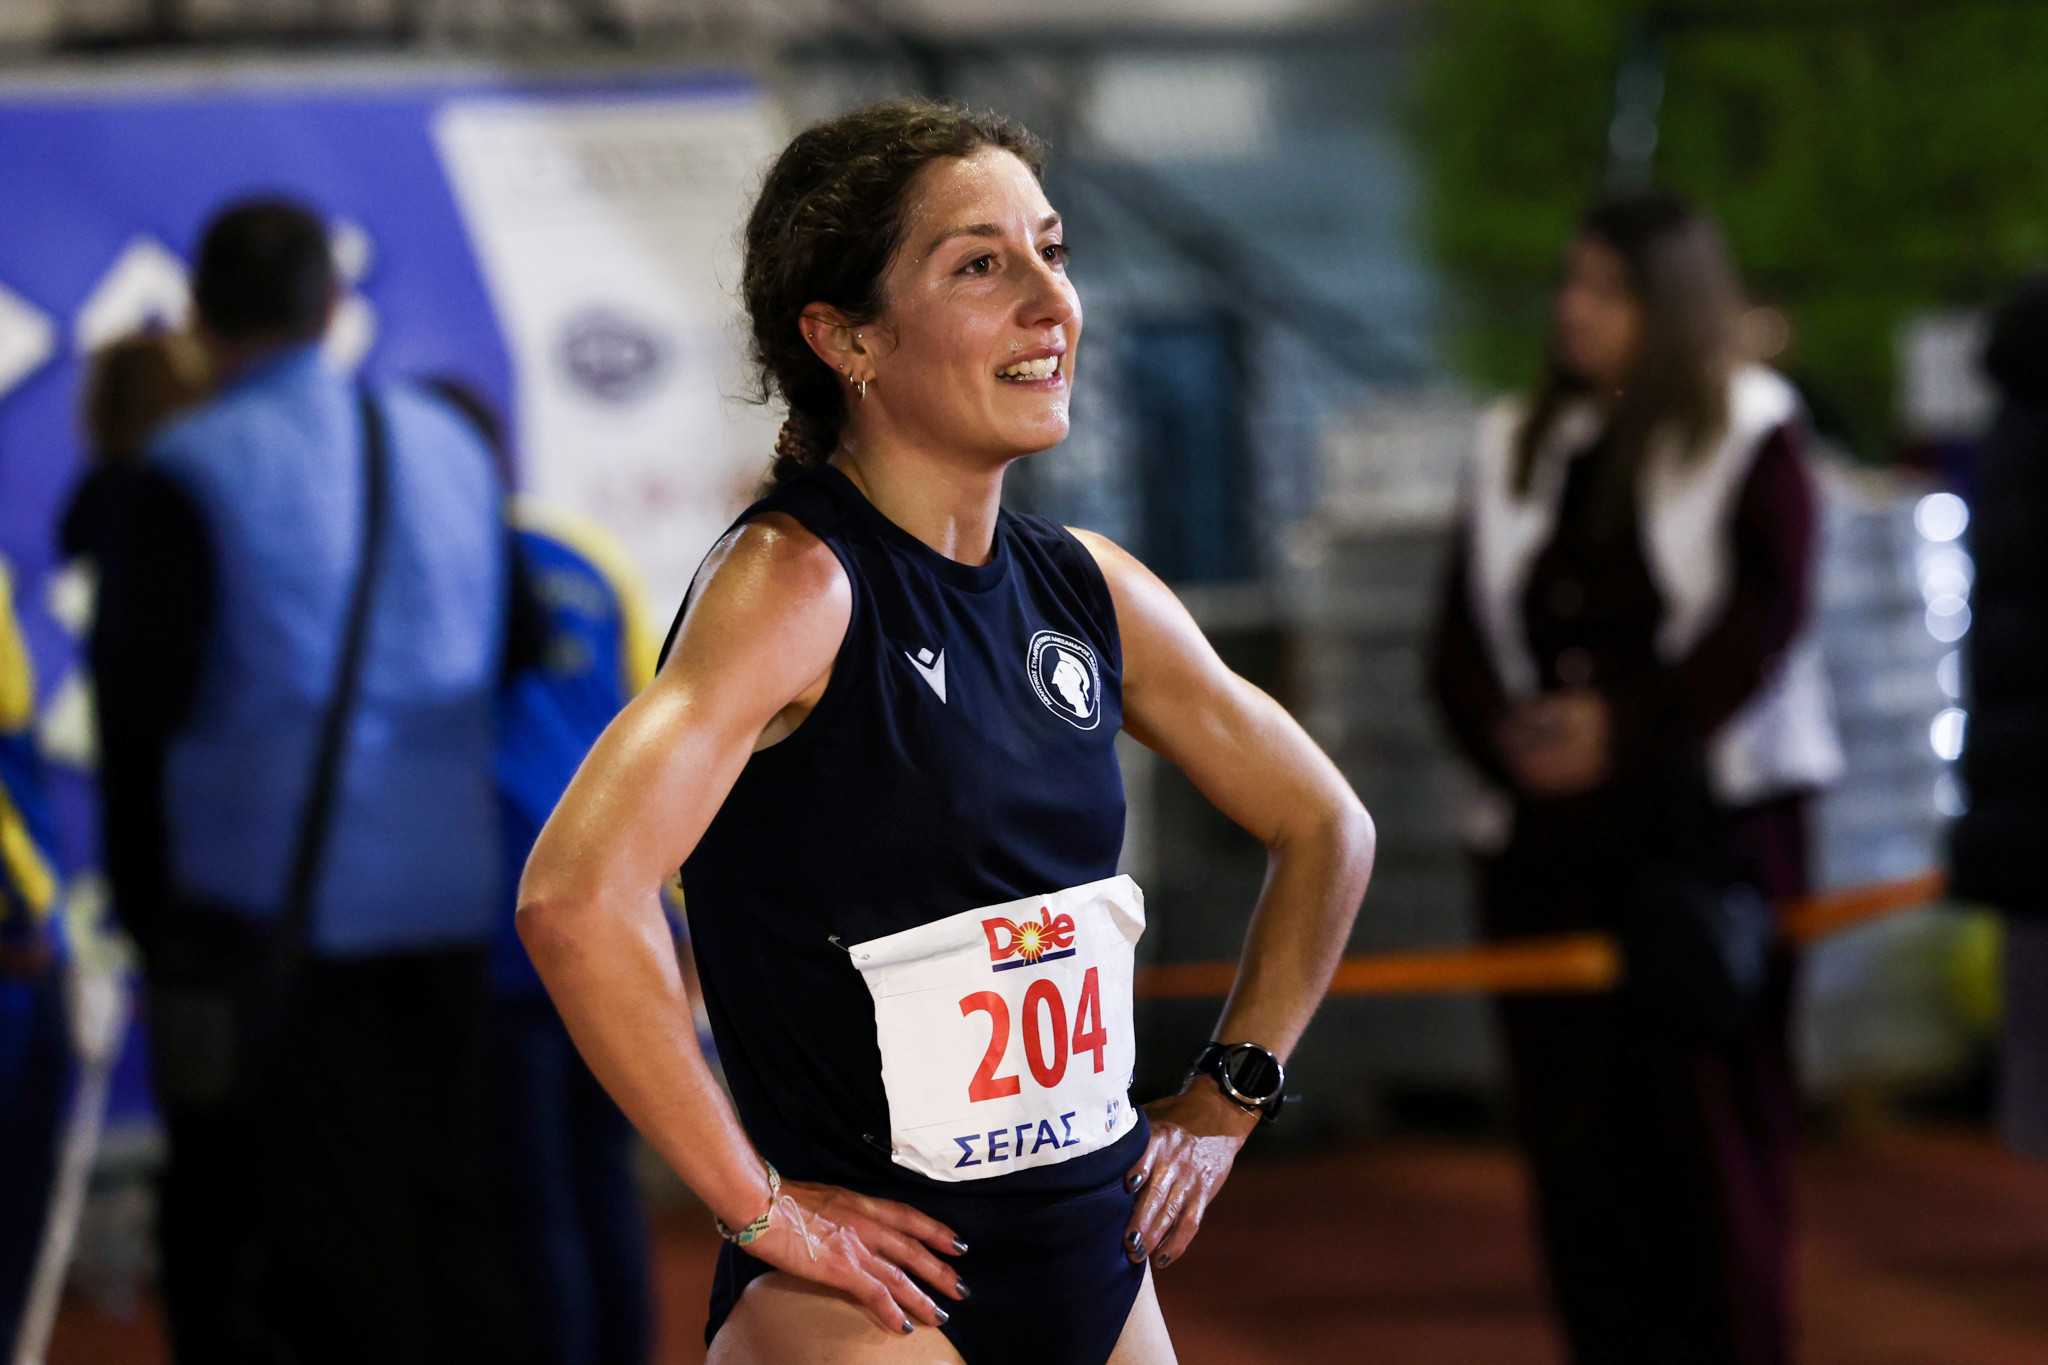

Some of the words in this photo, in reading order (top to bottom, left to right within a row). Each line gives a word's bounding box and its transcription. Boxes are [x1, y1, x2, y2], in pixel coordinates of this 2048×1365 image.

[981, 906, 1075, 961] Dole
[959, 966, 1107, 1103] 204
[953, 1111, 1081, 1168] ΣΕΓΑΣ
